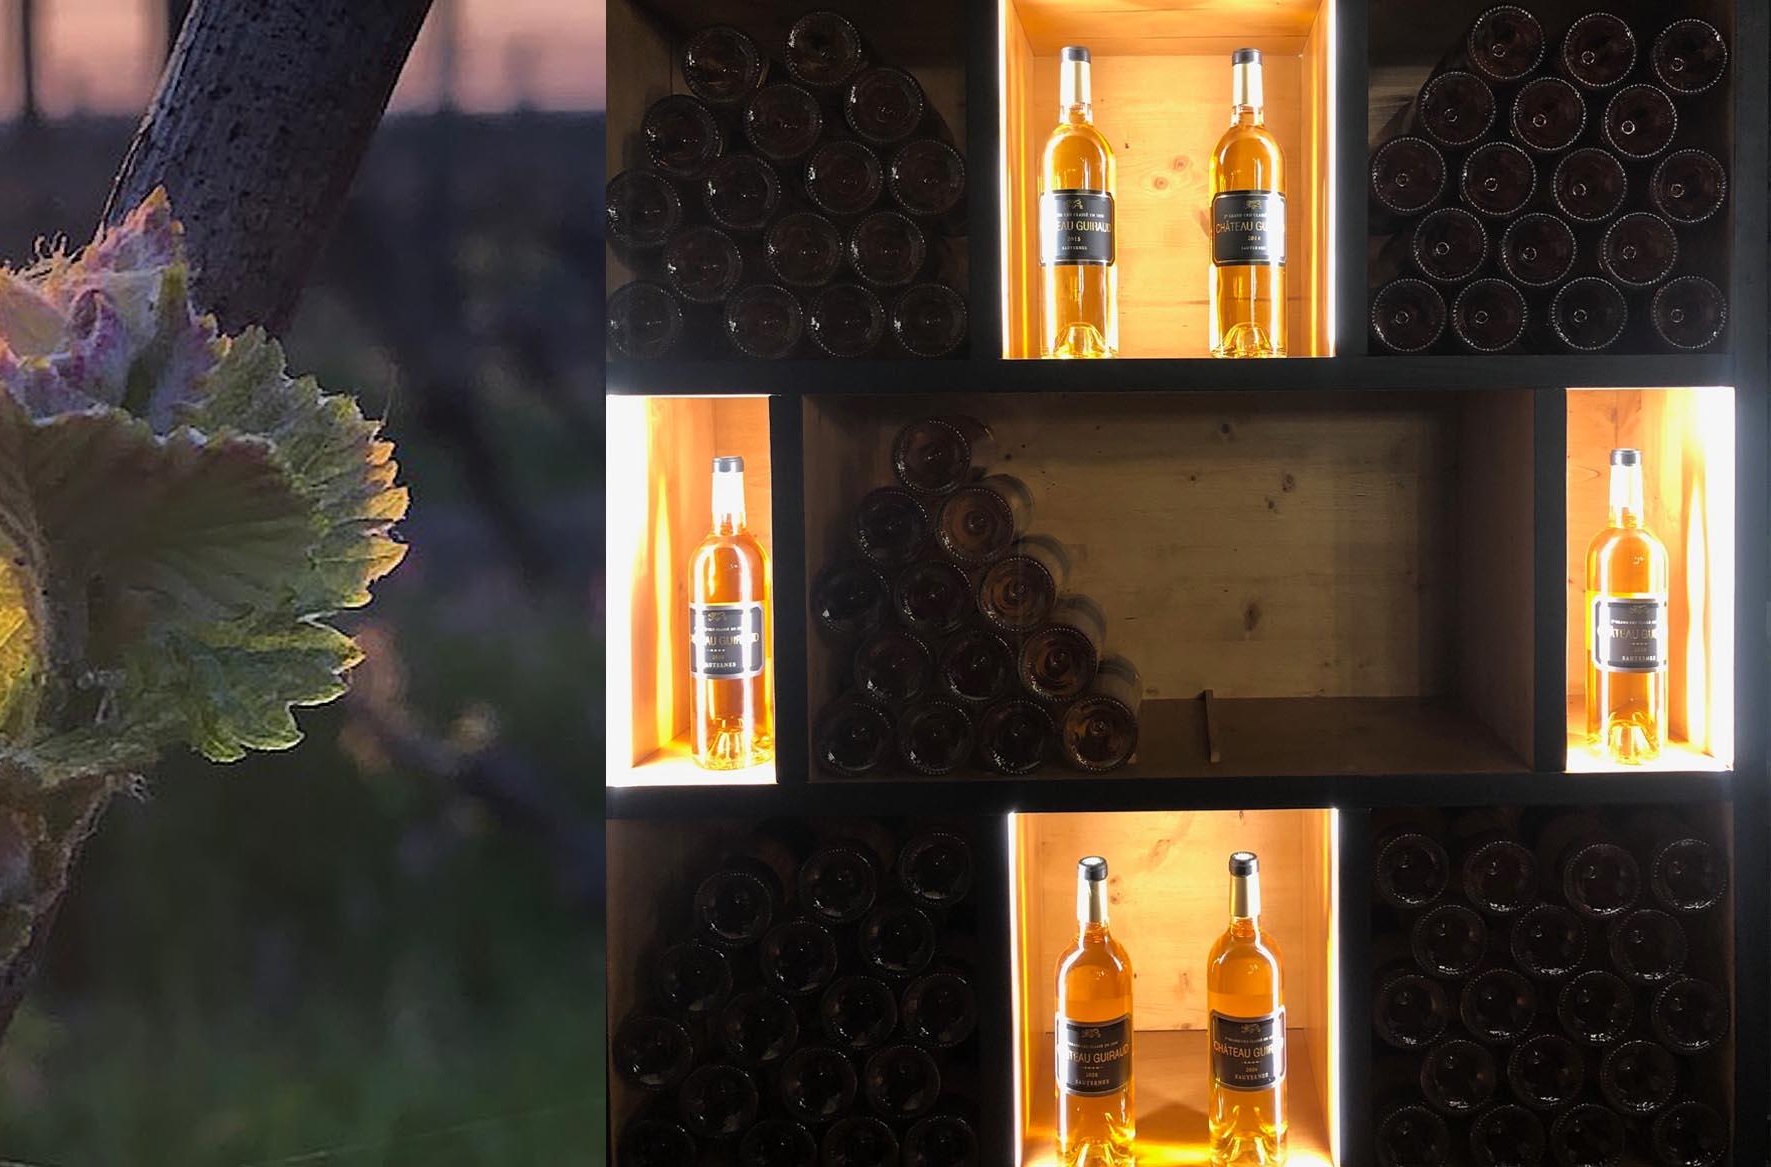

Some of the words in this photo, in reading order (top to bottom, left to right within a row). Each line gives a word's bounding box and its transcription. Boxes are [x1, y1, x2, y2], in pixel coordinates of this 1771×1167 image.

[1076, 220, 1111, 232] GUIRAUD
[1215, 220, 1253, 234] CHÂTEAU
[1093, 1043, 1129, 1063] GUIRAUD
[1213, 1040, 1251, 1058] CHÂTEAU
